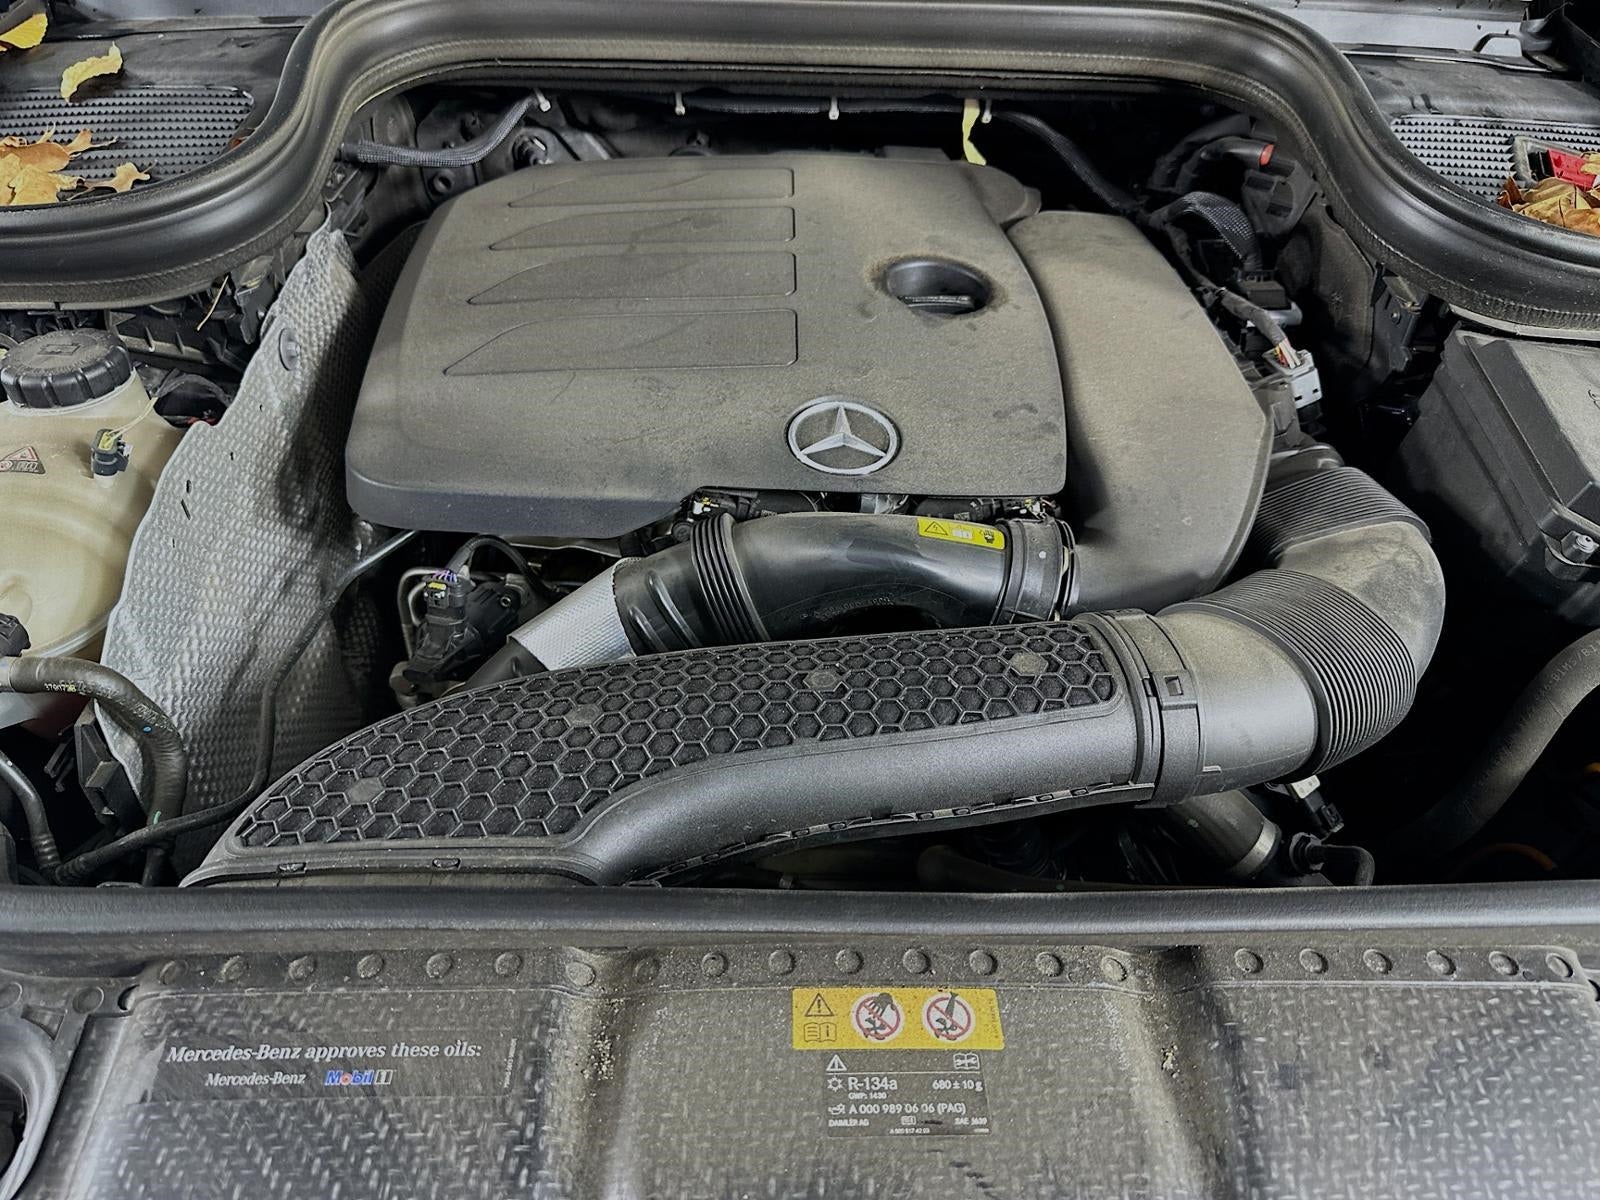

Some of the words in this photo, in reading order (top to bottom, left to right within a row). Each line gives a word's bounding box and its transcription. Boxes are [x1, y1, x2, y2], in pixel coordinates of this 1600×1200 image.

[166, 1044, 302, 1063] Mercedes-Benz
[304, 1045, 386, 1063] approves
[391, 1042, 440, 1058] these
[444, 1040, 482, 1058] oils:
[204, 1071, 307, 1087] Mercedes-Benz
[324, 1069, 375, 1086] Mobil
[847, 1076, 898, 1091] R-134a
[932, 1079, 952, 1090] 680
[962, 1079, 975, 1090] 10
[974, 1080, 984, 1092] g
[848, 1103, 858, 1115] A
[859, 1103, 880, 1115] 000
[882, 1103, 903, 1114] 989
[904, 1102, 920, 1114] 06
[921, 1102, 936, 1113] 06
[937, 1102, 967, 1115] (PAG)
